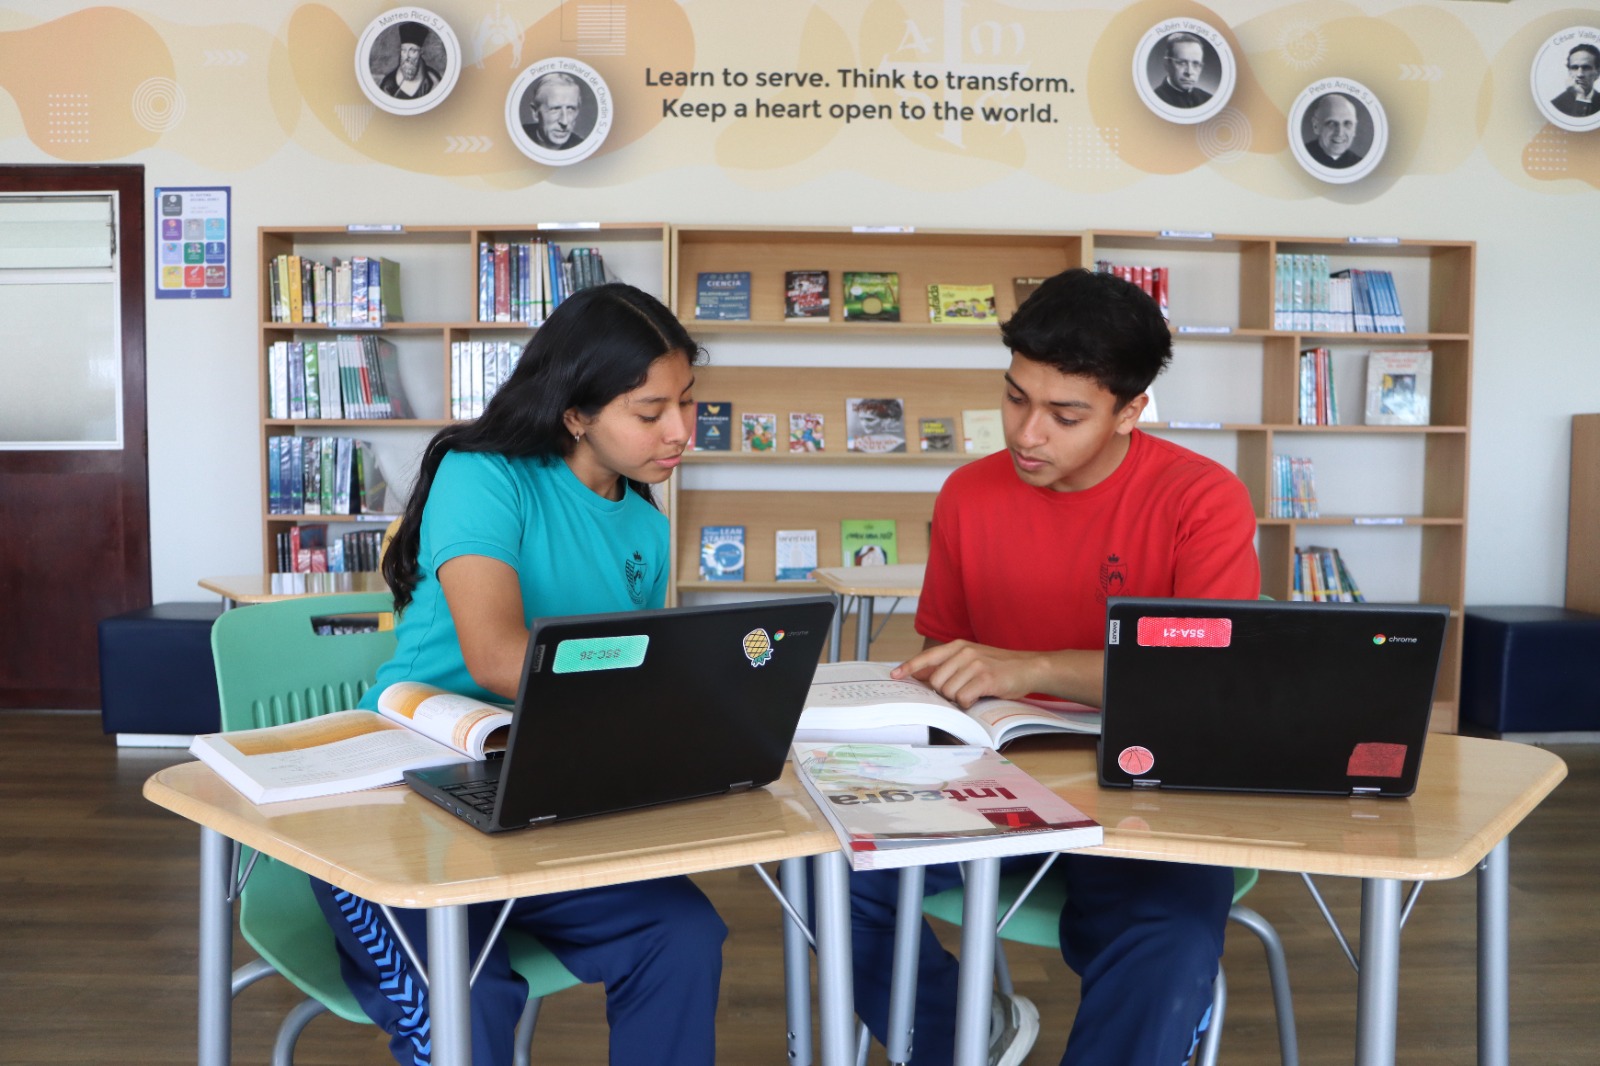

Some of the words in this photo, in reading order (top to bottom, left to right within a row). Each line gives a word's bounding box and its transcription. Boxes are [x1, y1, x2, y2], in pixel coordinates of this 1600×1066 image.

[378, 12, 409, 27] Matteo
[410, 10, 431, 22] Ricci
[1182, 21, 1210, 36] Vargas
[645, 68, 715, 87] Learn
[722, 68, 749, 87] to
[755, 71, 830, 88] serve.
[837, 68, 906, 89] Think
[913, 70, 939, 90] to
[946, 71, 1075, 93] transform.
[1308, 81, 1333, 95] Pedro
[1334, 80, 1360, 95] Arrupe
[530, 62, 556, 76] Pierre
[558, 61, 591, 78] Teilhard
[588, 76, 599, 87] de
[596, 86, 609, 119] Chardin
[662, 98, 727, 123] Keep
[734, 102, 748, 118] a
[756, 98, 822, 119] heart
[829, 103, 893, 124] open
[900, 101, 926, 121] to
[933, 101, 975, 121] the
[981, 103, 1059, 124] world.
[720, 528, 742, 536] LEAN
[1111, 621, 1119, 644] Lenovo
[1163, 628, 1205, 638] S5A-21
[1388, 635, 1418, 644] chrome
